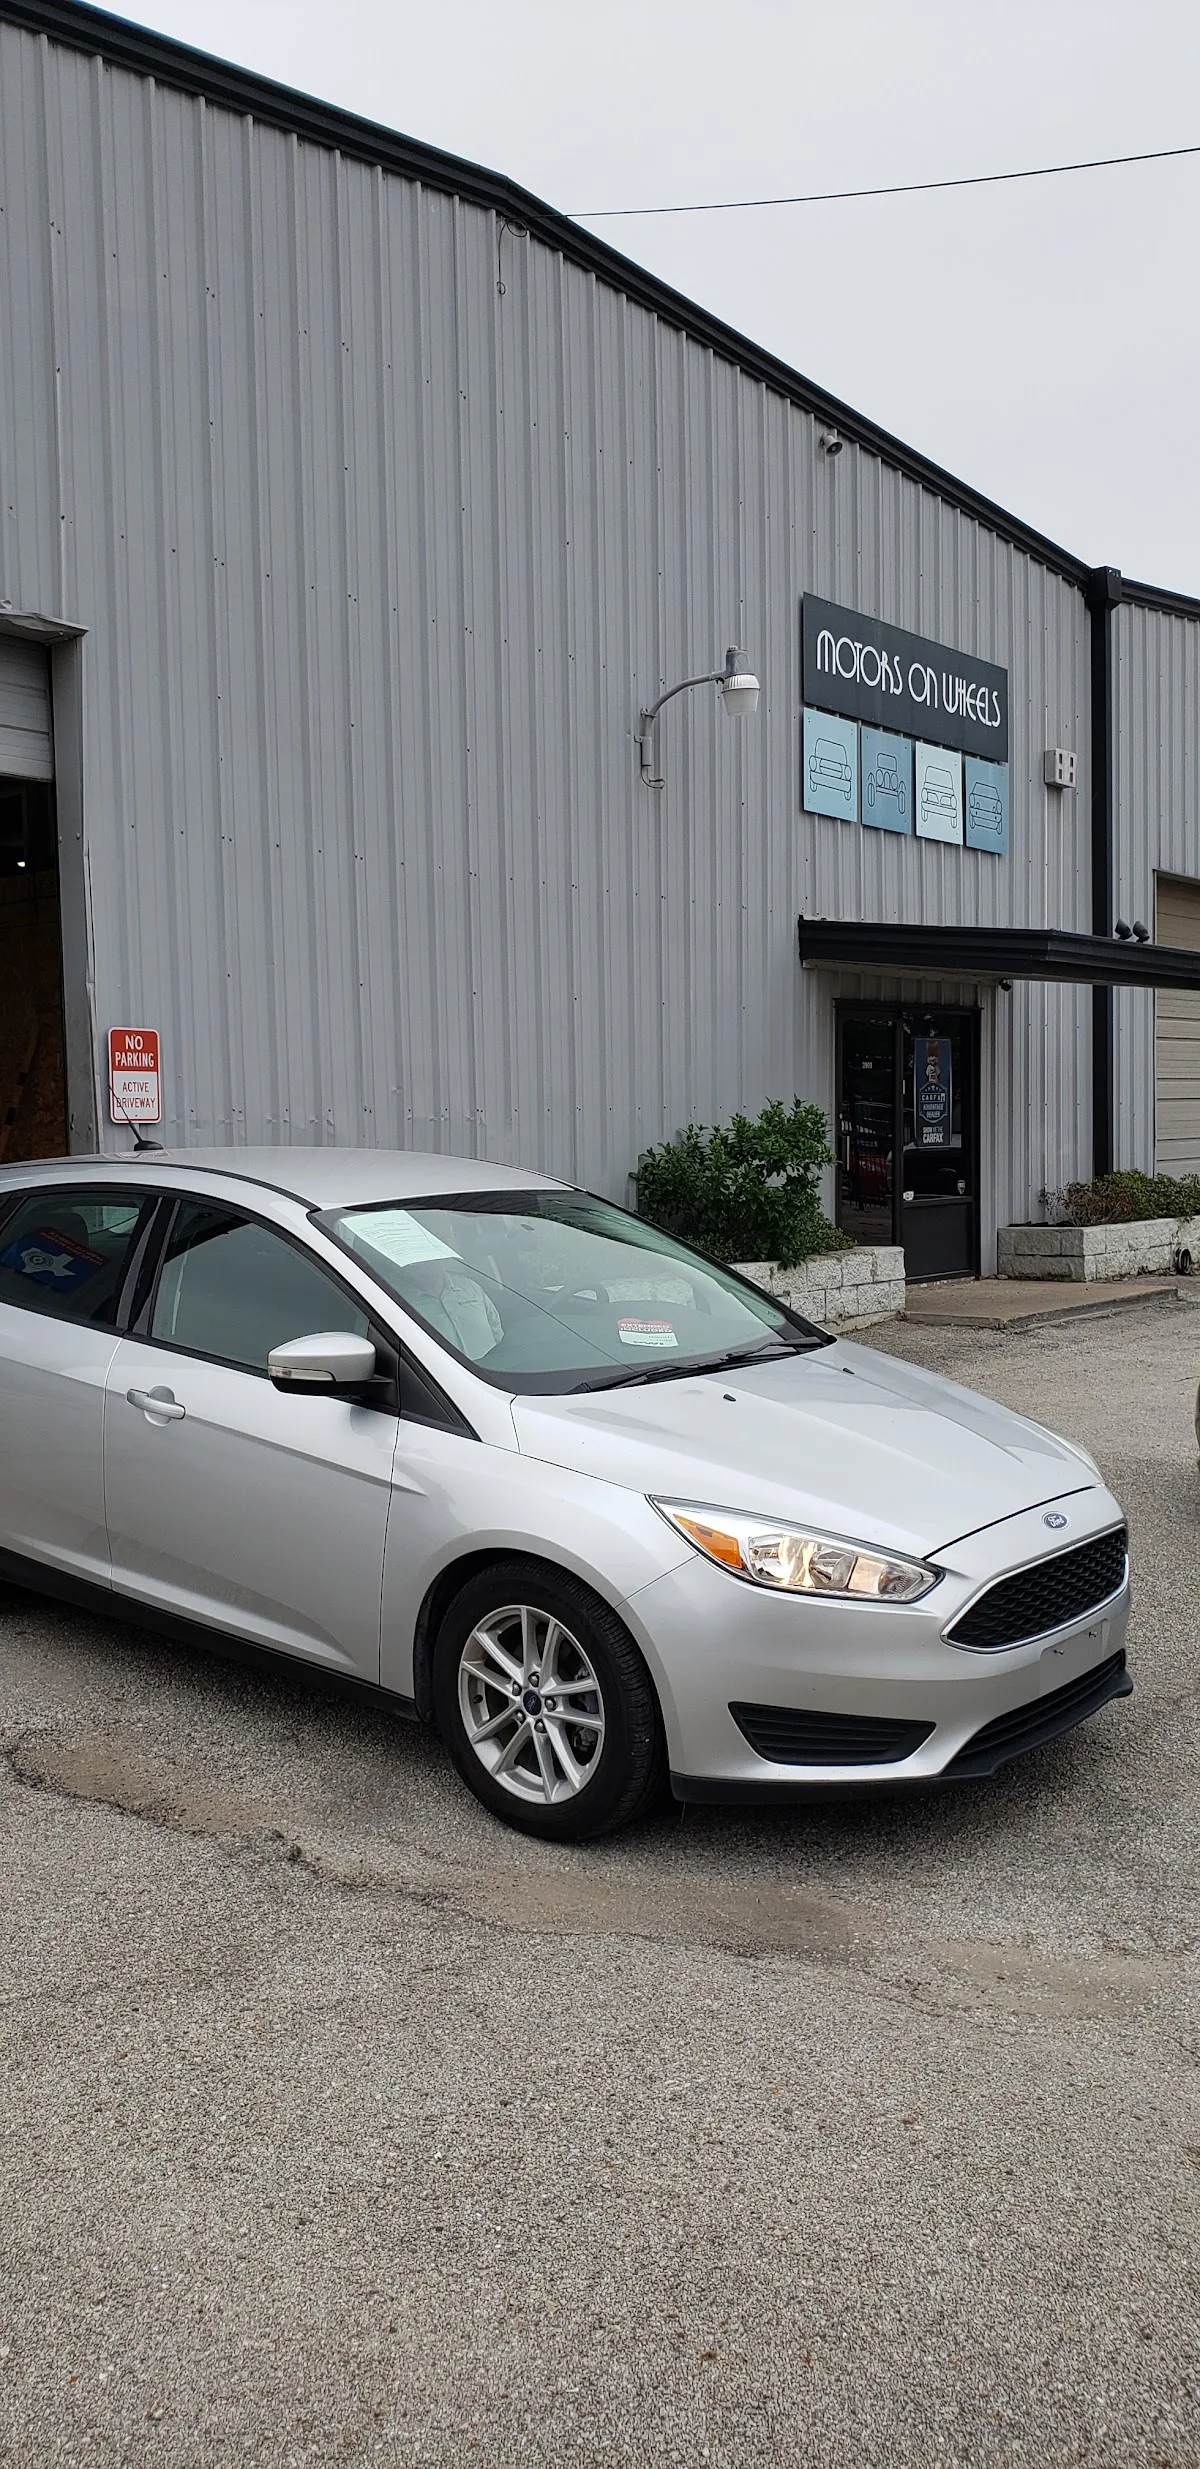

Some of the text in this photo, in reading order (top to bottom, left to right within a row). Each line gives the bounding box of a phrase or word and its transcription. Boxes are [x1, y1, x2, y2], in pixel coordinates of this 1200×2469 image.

[817, 629, 1001, 728] MOTORS ON WHEELS
[125, 1034, 143, 1050] NO
[115, 1051, 154, 1067] PARKING
[122, 1081, 149, 1092] ACTIVE
[116, 1097, 155, 1108] DRIVEWAY
[922, 1133, 944, 1144] CARFAX
